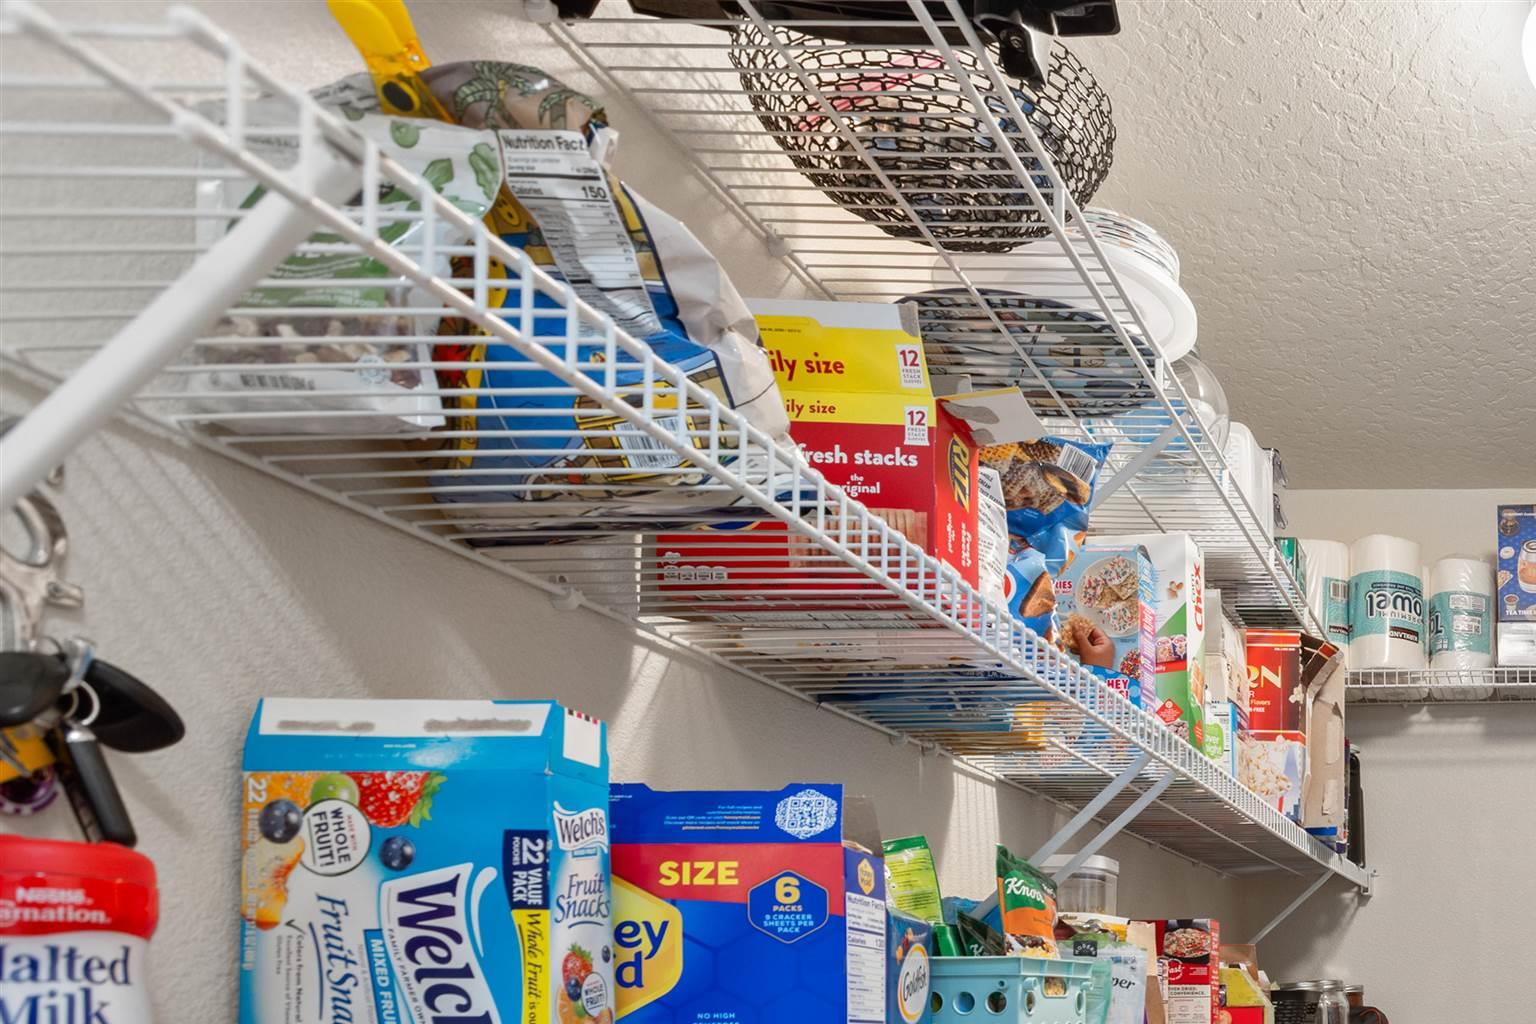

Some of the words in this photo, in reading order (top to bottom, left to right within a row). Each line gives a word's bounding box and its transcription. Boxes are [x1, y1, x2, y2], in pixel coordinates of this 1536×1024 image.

[502, 135, 554, 150] Nutrition
[511, 185, 543, 195] Calories
[581, 186, 607, 199] 150
[769, 350, 796, 380] ily
[804, 352, 845, 375] size
[899, 350, 920, 367] 12
[786, 400, 804, 417] ily
[809, 401, 836, 414] size
[907, 411, 925, 425] 12
[797, 443, 848, 464] fresh
[854, 449, 918, 467] stacks
[952, 433, 970, 512] RITZ
[247, 778, 267, 802] 22
[312, 810, 336, 867] FRUIT!
[330, 807, 351, 863] WHOLE
[558, 811, 606, 845] Welch's
[511, 836, 521, 866] POUCHES
[521, 837, 544, 865] 22
[512, 871, 530, 903] PACK
[526, 868, 544, 906] VALUE
[567, 873, 604, 898] Fruit
[658, 861, 740, 887] SIZE
[775, 876, 800, 904] 6
[554, 894, 611, 925] Snacks
[772, 905, 803, 913] PACKS
[315, 893, 356, 969] Fruit
[526, 912, 544, 959] Whole
[614, 919, 671, 960] ey
[368, 939, 391, 988] MIXED
[387, 928, 403, 962] FAMILY
[399, 965, 417, 1003] FARMER
[616, 950, 644, 988] d
[527, 962, 543, 999] Fruit
[903, 966, 927, 1002] Goldfish
[529, 1001, 540, 1012] is
